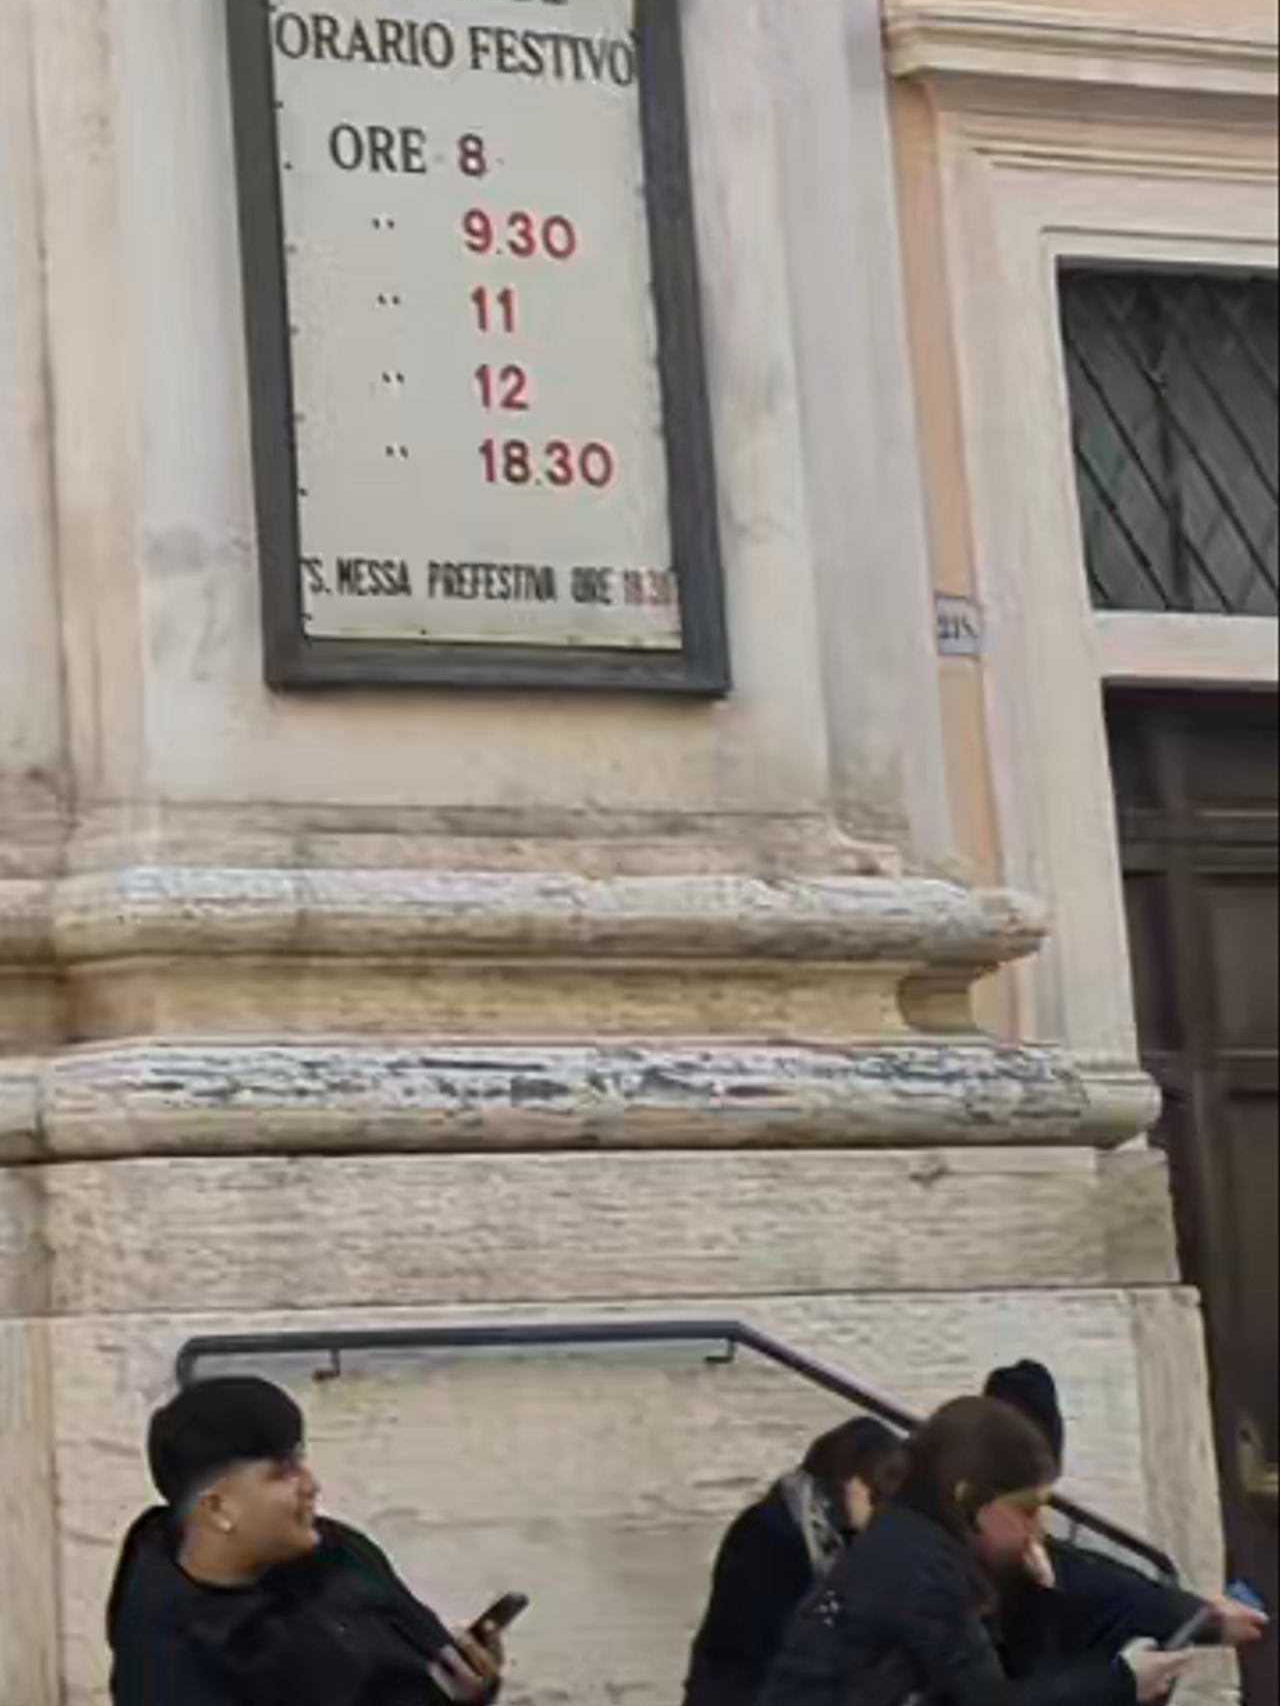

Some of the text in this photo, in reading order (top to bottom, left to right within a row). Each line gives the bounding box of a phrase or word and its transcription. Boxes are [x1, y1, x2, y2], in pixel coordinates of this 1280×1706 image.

[274, 12, 635, 86] ORARIO FESTIVO
[329, 123, 488, 178] ORE 8
[463, 207, 577, 259] 9.30
[471, 285, 514, 333] 11
[474, 363, 529, 410] 12
[479, 438, 614, 487] 18.30
[336, 557, 412, 597] MESSA
[427, 559, 557, 604] PREFESTIVA
[571, 566, 613, 606] ORE
